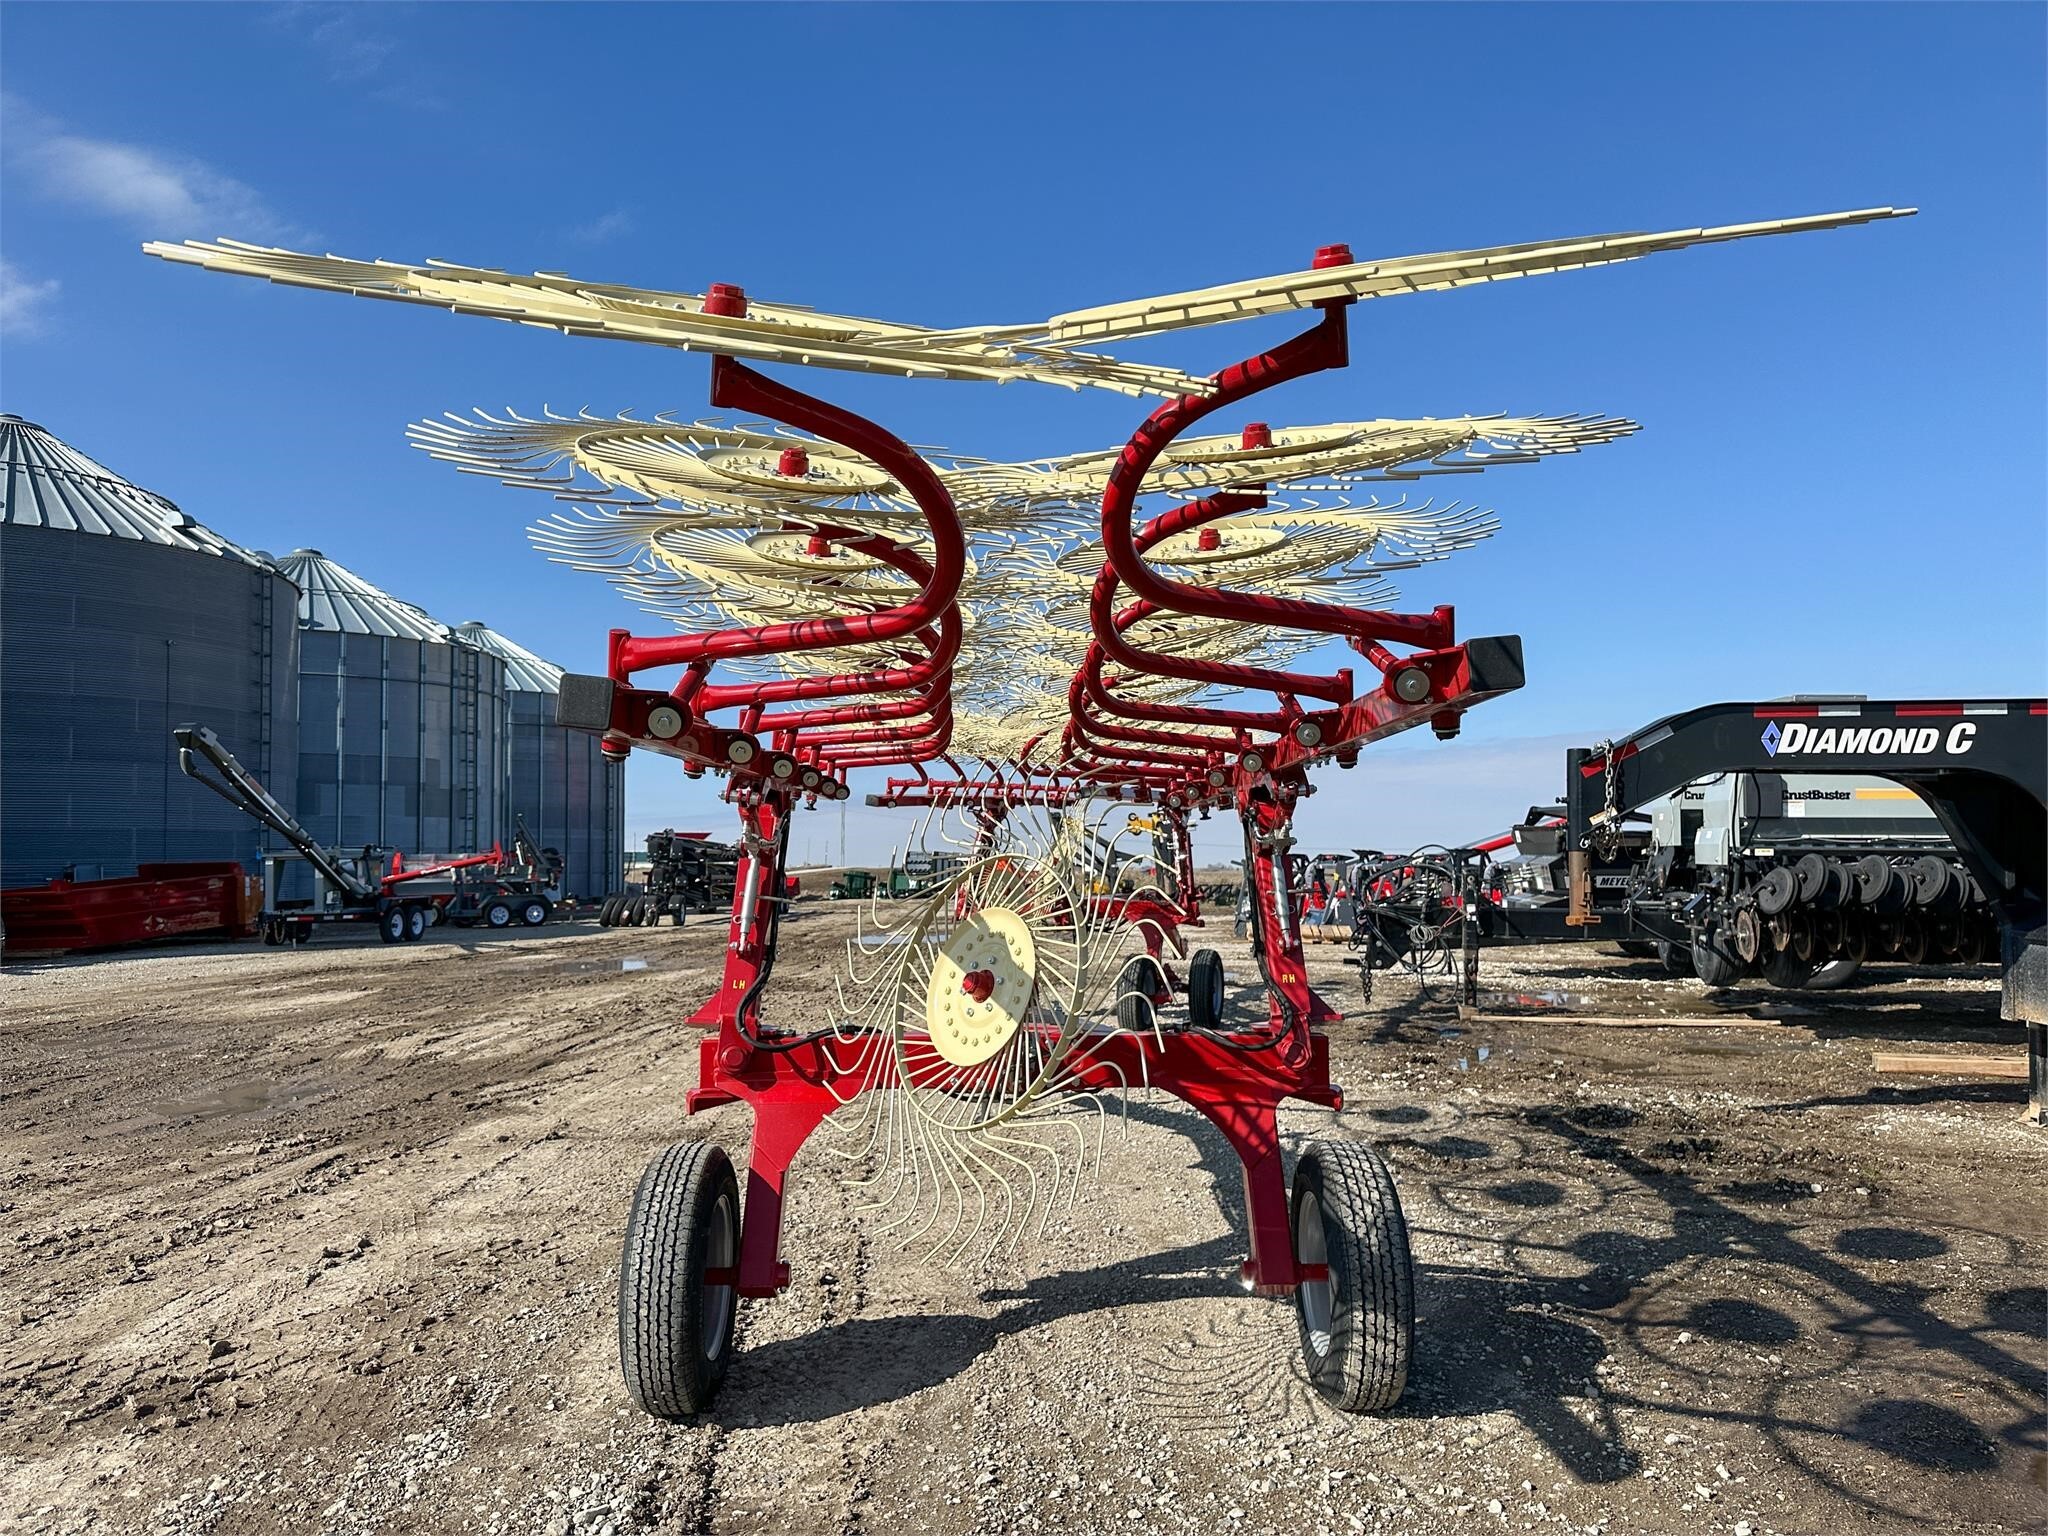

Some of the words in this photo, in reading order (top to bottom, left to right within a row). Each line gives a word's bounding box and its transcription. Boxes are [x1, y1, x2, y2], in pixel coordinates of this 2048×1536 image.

[1776, 722, 1940, 754] DIAMOND
[1945, 721, 1977, 755] C
[1782, 789, 1851, 800] CrustBuster
[1282, 973, 1296, 984] RH
[732, 979, 746, 990] LH
